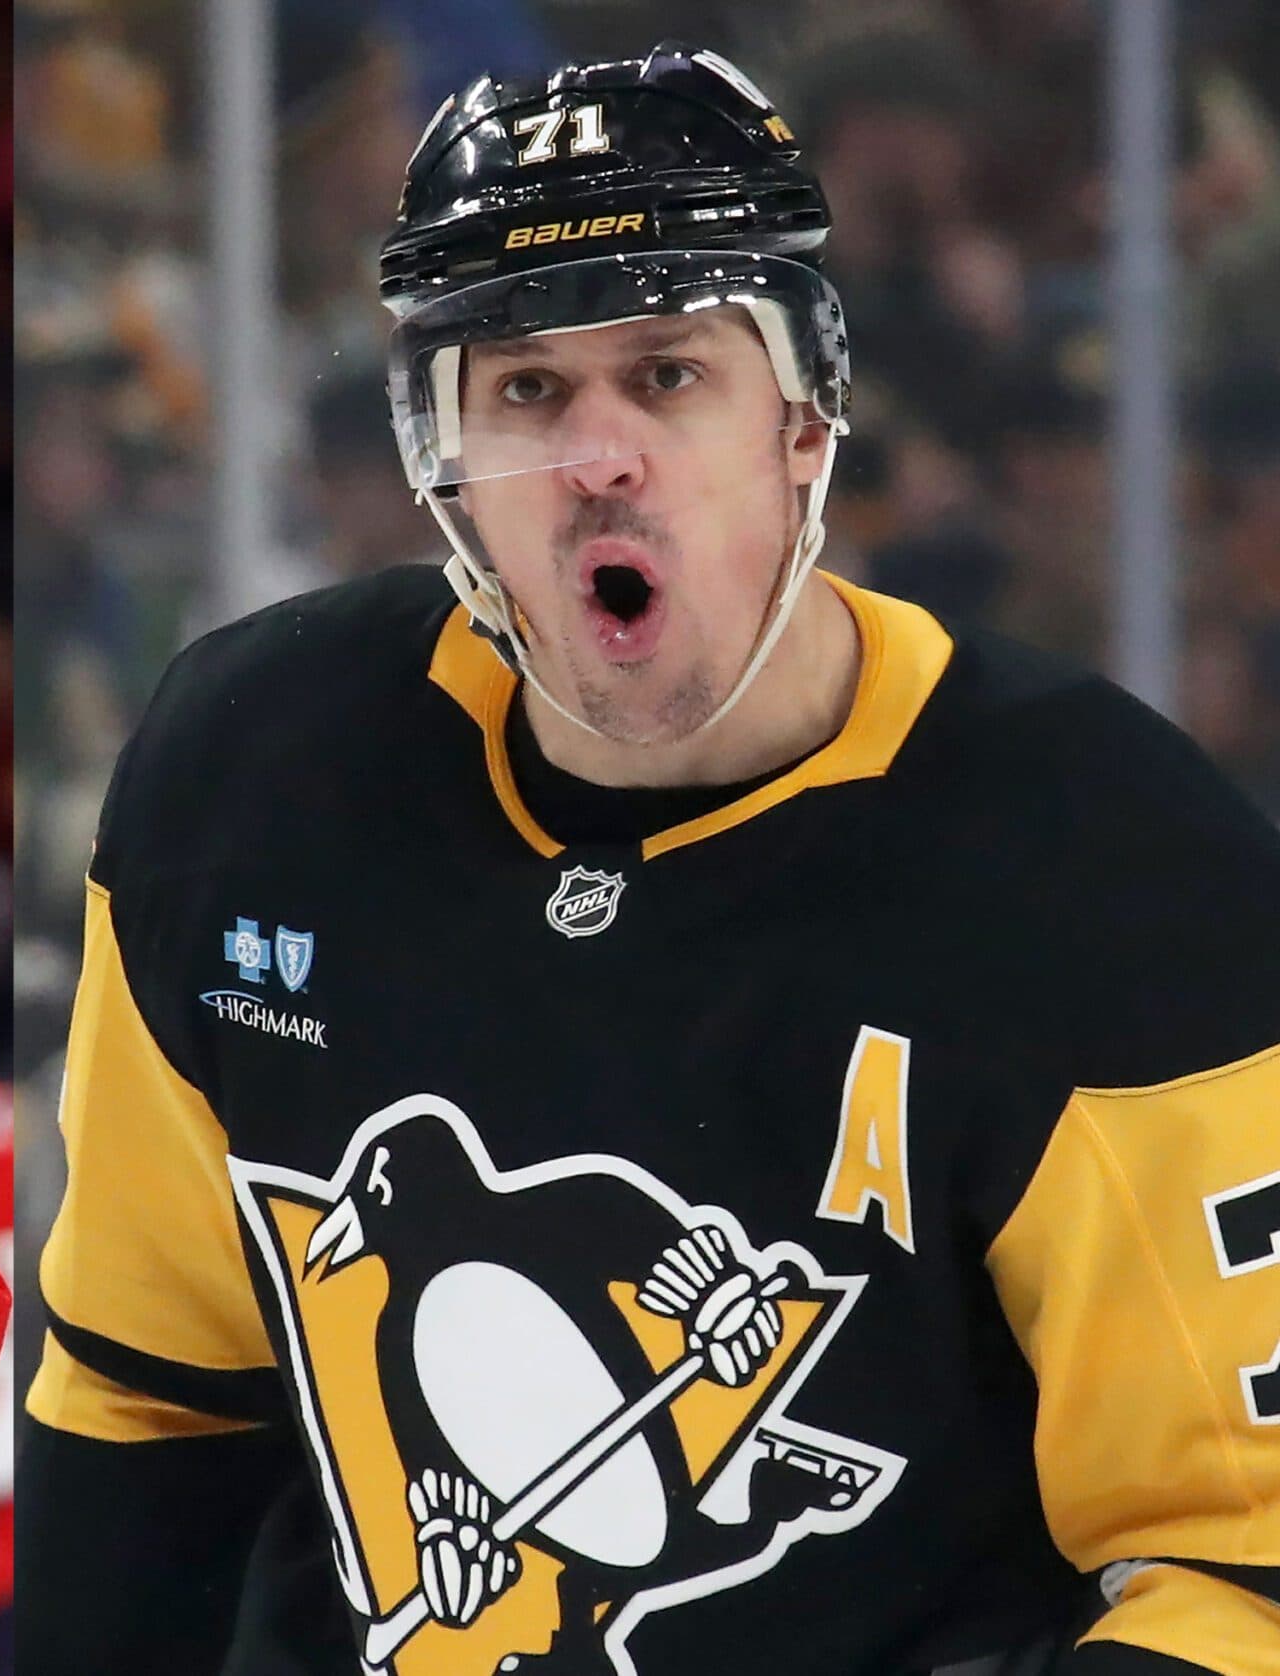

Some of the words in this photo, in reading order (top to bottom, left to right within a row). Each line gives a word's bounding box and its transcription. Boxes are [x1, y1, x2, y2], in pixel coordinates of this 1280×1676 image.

[513, 104, 610, 168] 71
[504, 212, 645, 250] BAUER
[560, 890, 611, 919] NHL
[216, 995, 329, 1048] HIGHMARK
[815, 1024, 916, 1255] A
